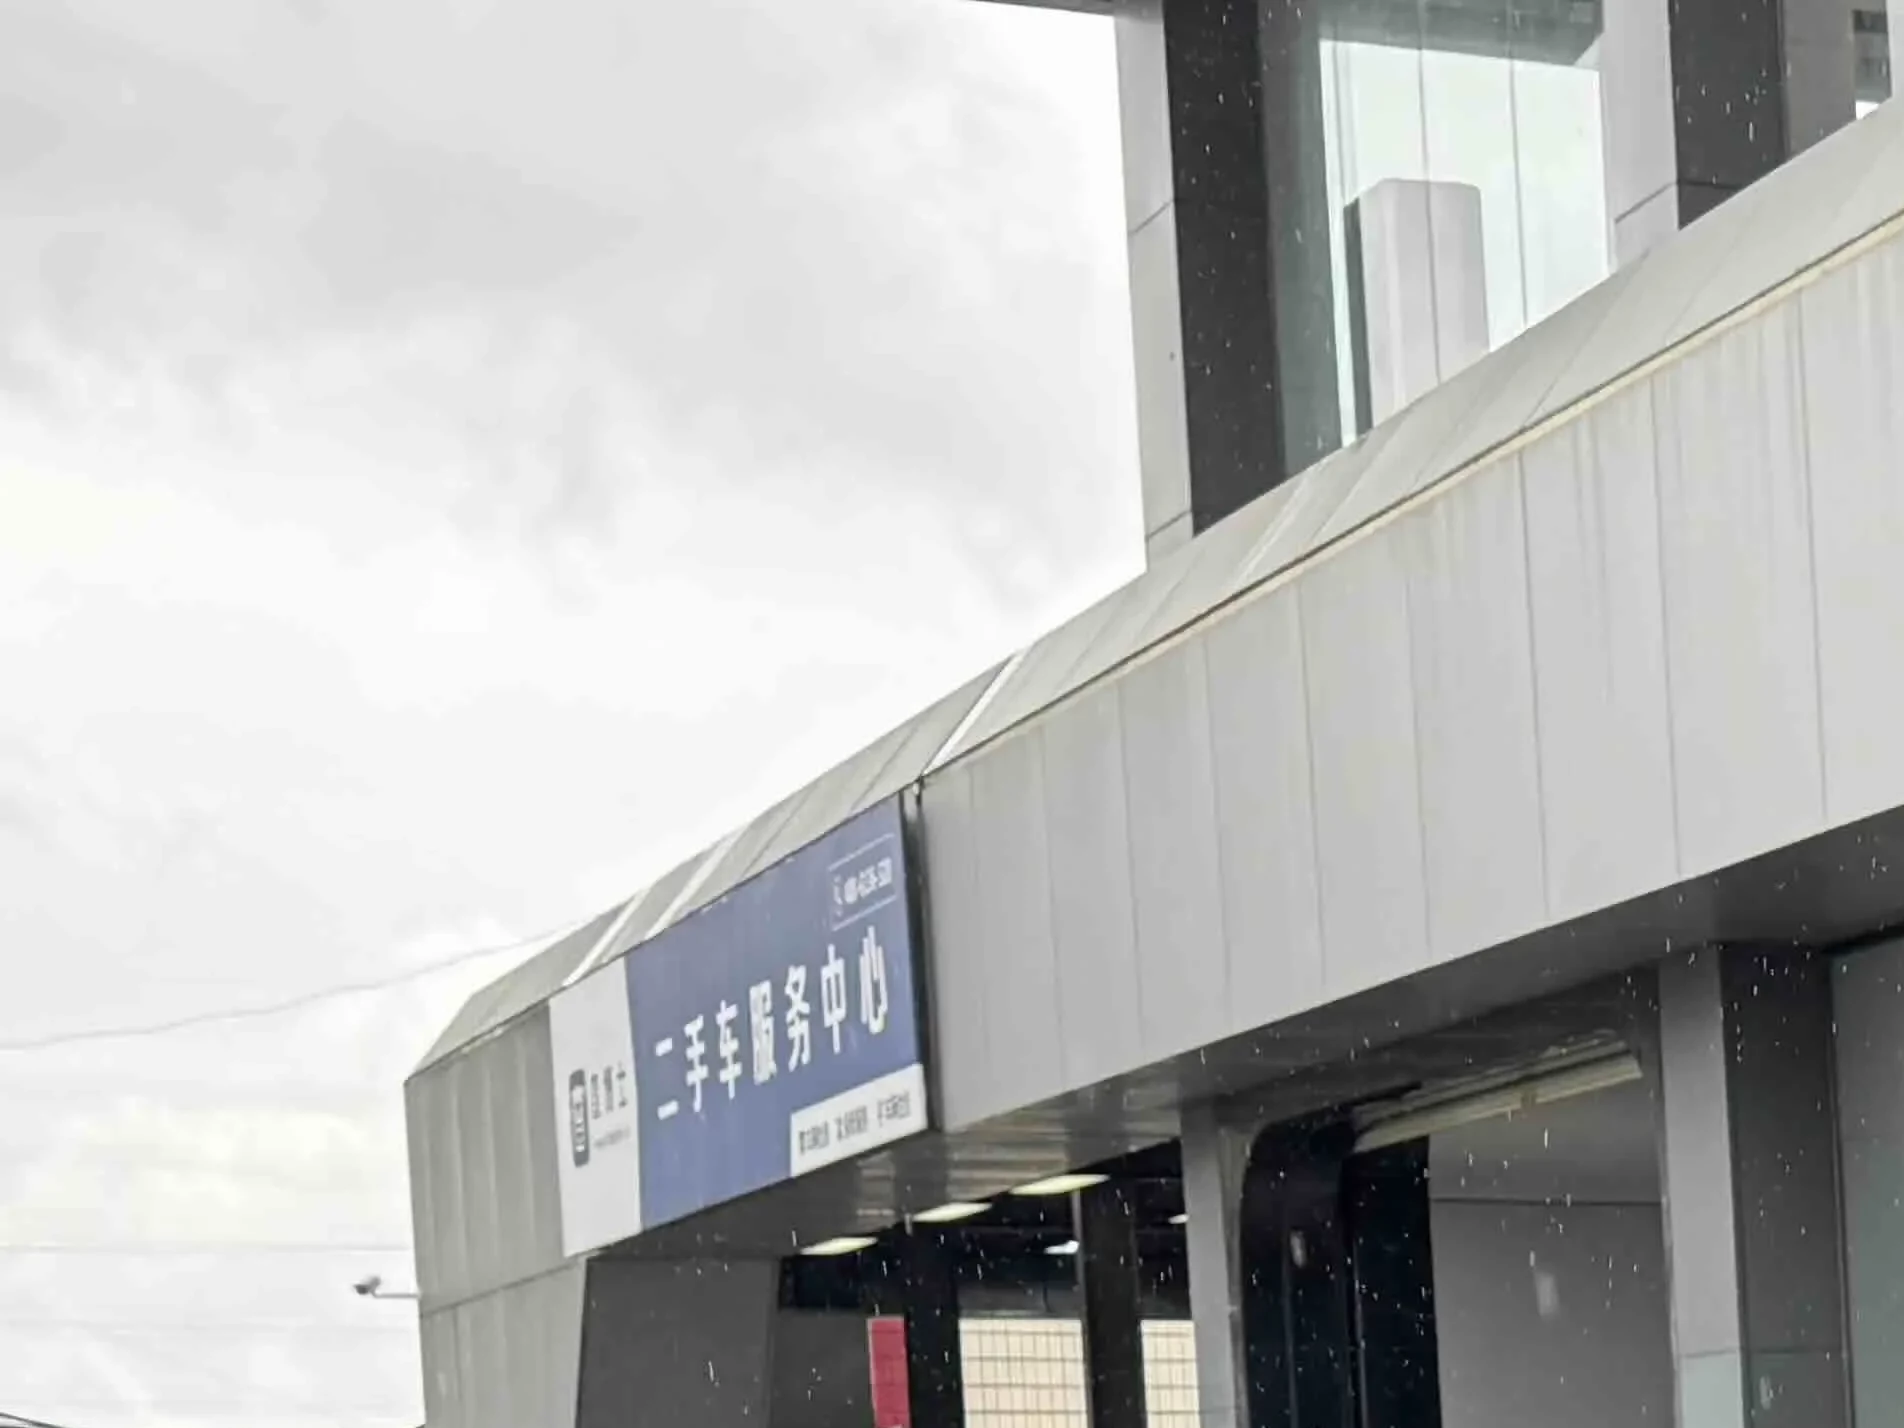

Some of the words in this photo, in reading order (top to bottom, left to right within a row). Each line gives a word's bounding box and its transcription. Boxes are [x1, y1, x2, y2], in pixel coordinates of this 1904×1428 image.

[655, 926, 888, 1120] 二手车服务中心
